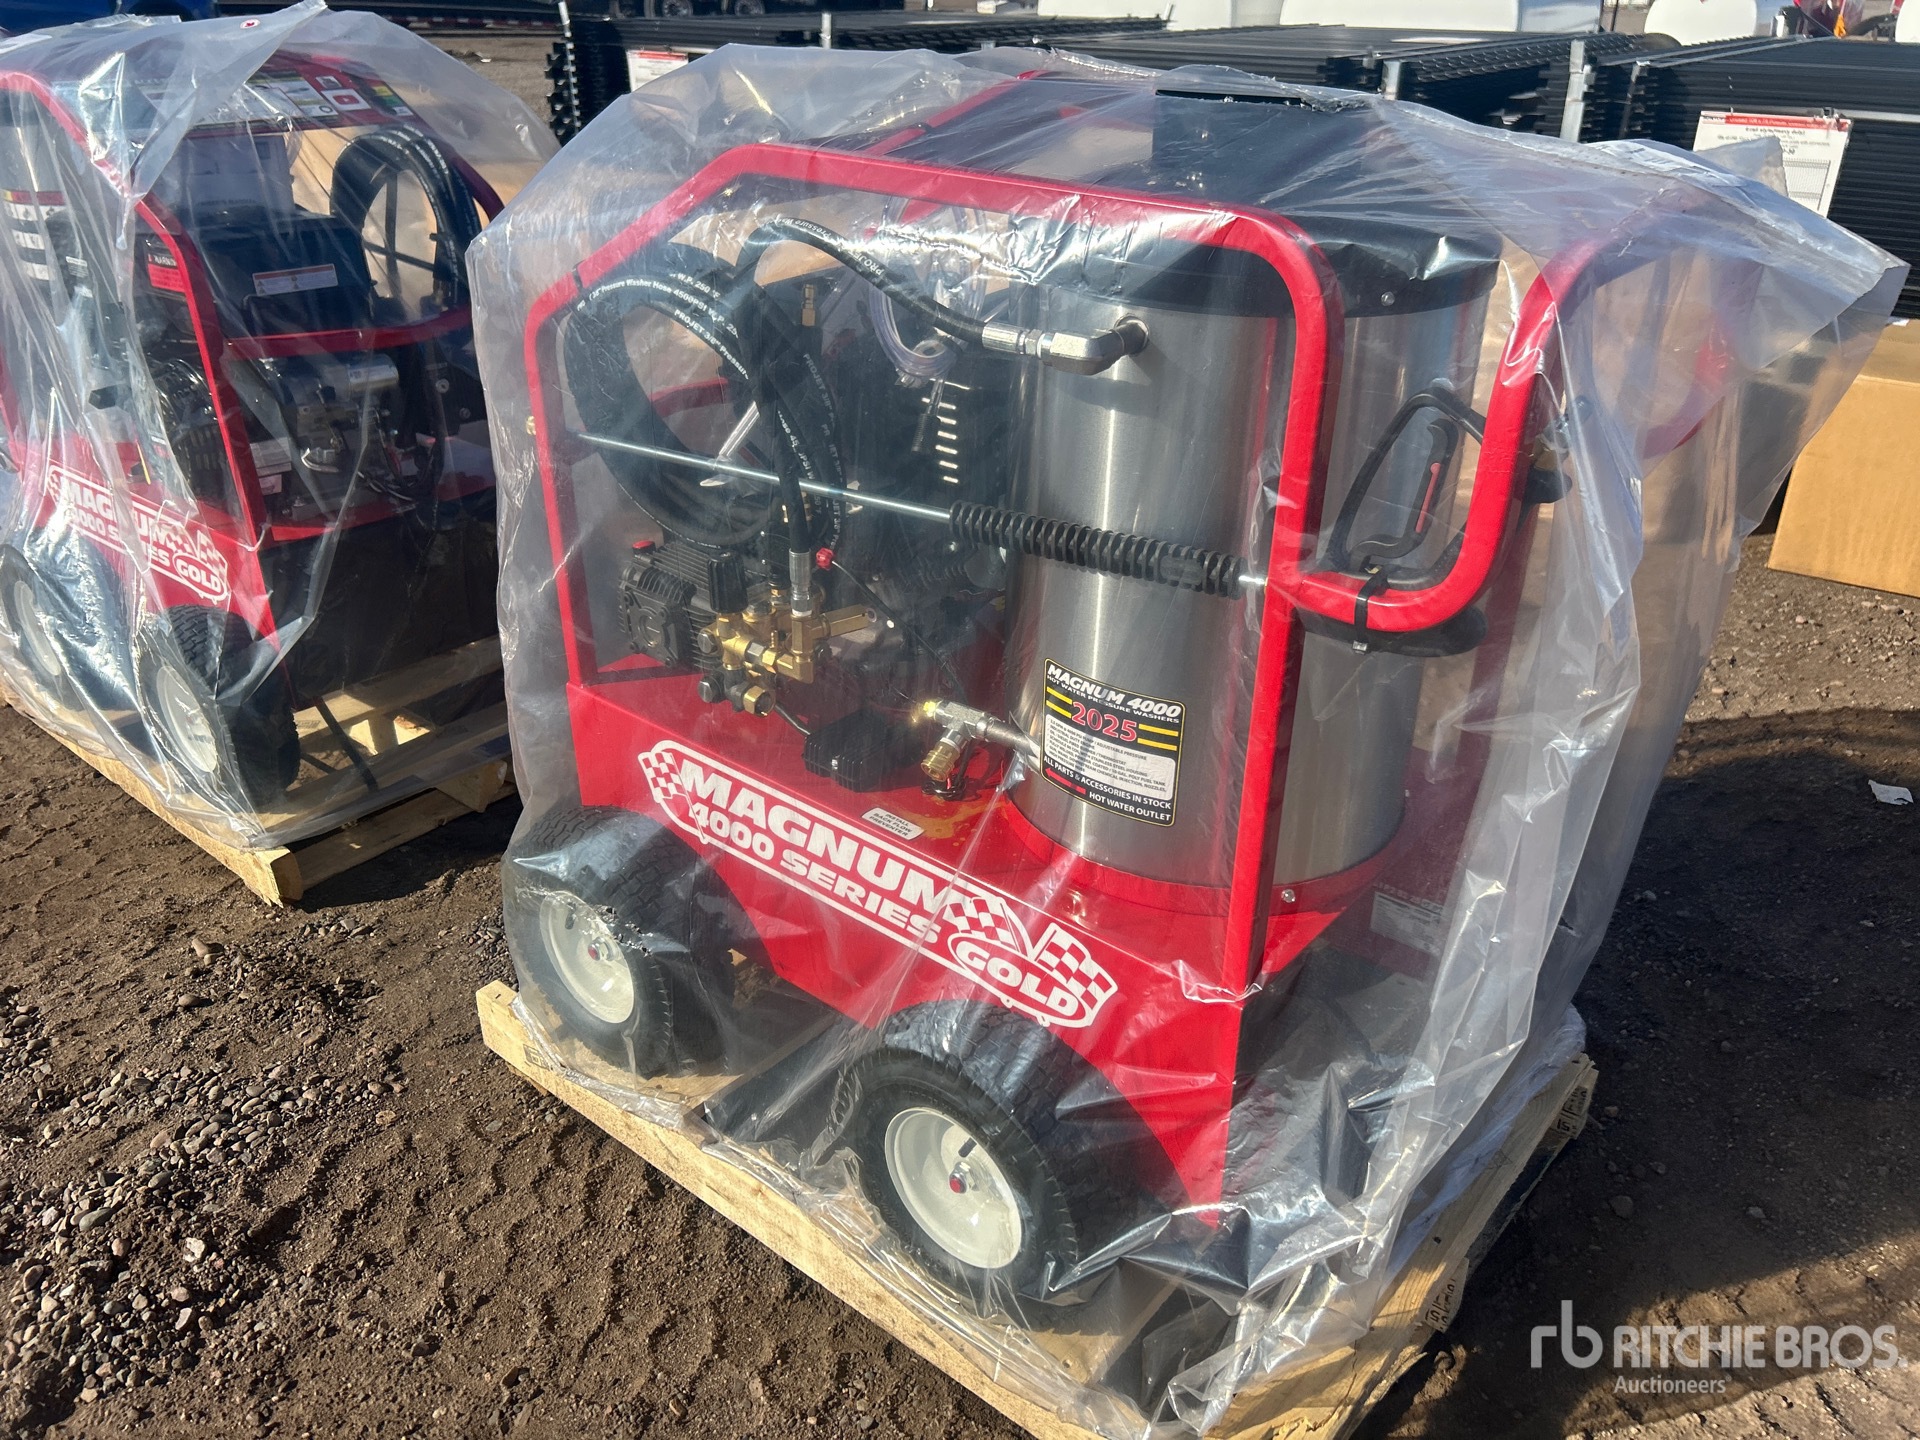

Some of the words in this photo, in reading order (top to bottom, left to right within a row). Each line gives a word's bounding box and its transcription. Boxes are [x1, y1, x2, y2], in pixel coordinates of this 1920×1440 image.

[794, 219, 832, 238] Pressure
[601, 280, 625, 292] Pressure
[626, 279, 652, 287] Washer
[652, 281, 672, 294] Hose
[694, 280, 711, 294] 250
[674, 309, 704, 334] PROJET
[803, 353, 826, 390] PROJET
[176, 559, 224, 592] GOLD
[1047, 675, 1060, 685] HOT
[1060, 682, 1086, 698] WATER
[1088, 695, 1130, 713] PRESSURE
[1132, 710, 1180, 724] WASHERS
[1048, 664, 1126, 704] MAGNUM
[1127, 698, 1182, 718] 4000
[1072, 702, 1137, 742] 2025
[1044, 755, 1055, 768] ALL
[1055, 762, 1074, 778] PARTS
[1081, 776, 1131, 800] ACCESSORIES
[1132, 794, 1142, 804] IN
[1143, 798, 1172, 810] STOCK
[873, 812, 891, 823] BACK
[892, 822, 912, 832] FLOW
[885, 813, 909, 826] INSTALL
[1089, 791, 1105, 804] HOT
[1106, 797, 1134, 814] WATER
[1136, 806, 1171, 820] OUTLET
[676, 759, 967, 914] MAGNUM
[869, 816, 908, 836] PREVENTER
[688, 802, 774, 860] 4000
[780, 848, 941, 944] SERIES
[956, 940, 1079, 1016] GOLD
